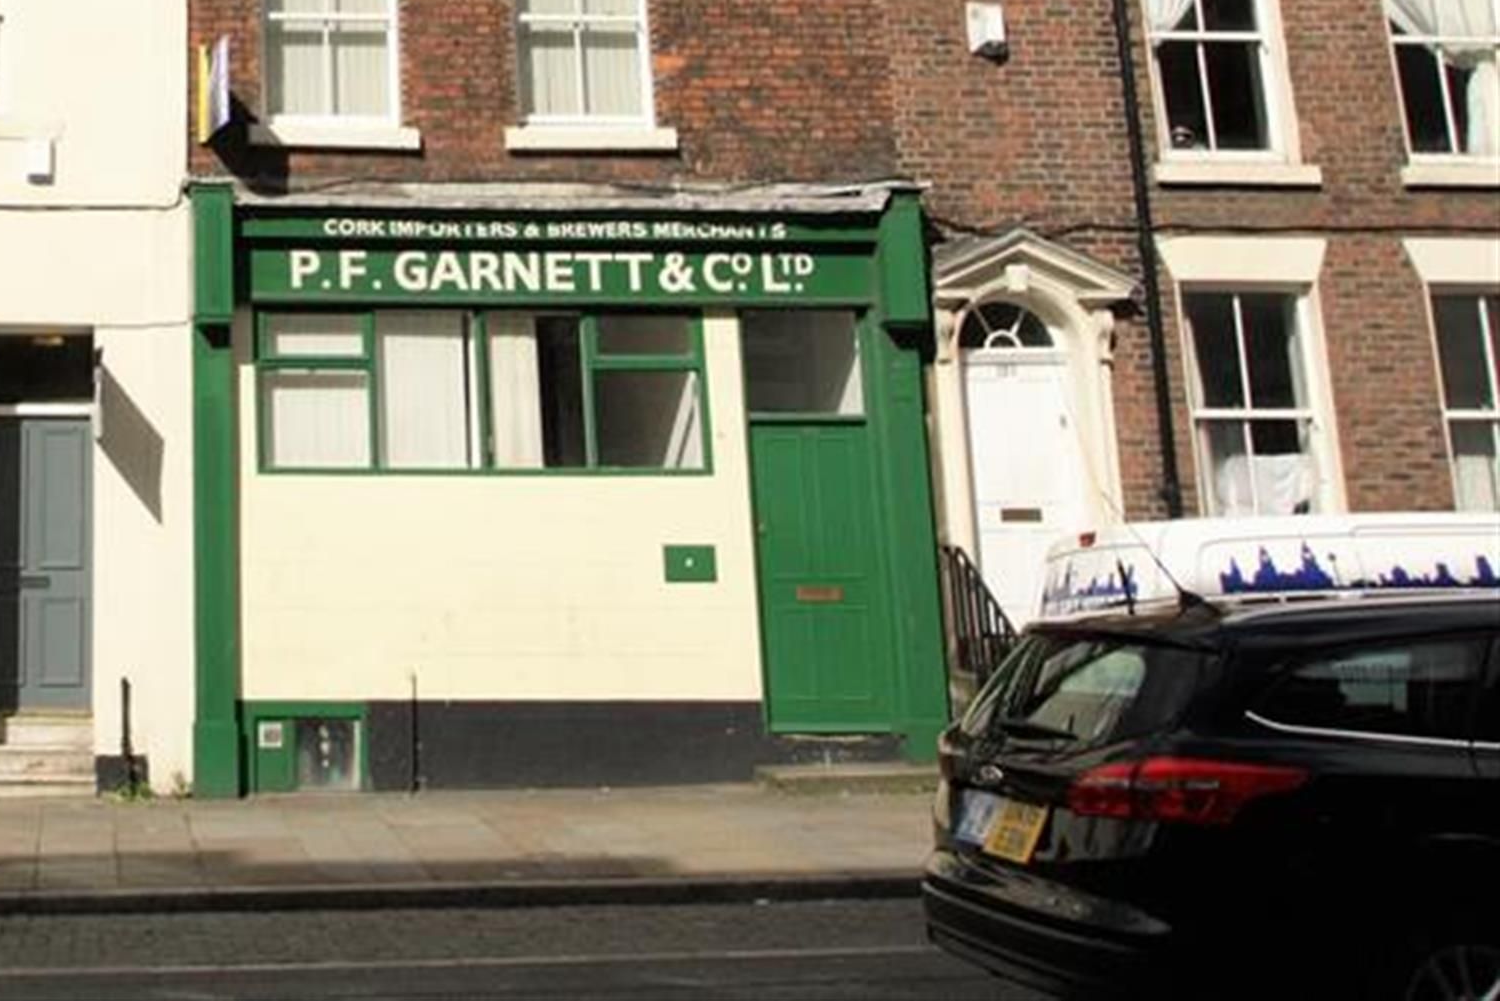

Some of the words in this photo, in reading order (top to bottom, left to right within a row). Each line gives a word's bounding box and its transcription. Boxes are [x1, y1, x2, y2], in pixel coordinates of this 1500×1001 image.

[323, 218, 385, 237] CORK
[523, 222, 541, 239] &
[547, 222, 647, 239] BREWERS
[393, 251, 655, 292] GARNETT
[658, 252, 697, 293] &
